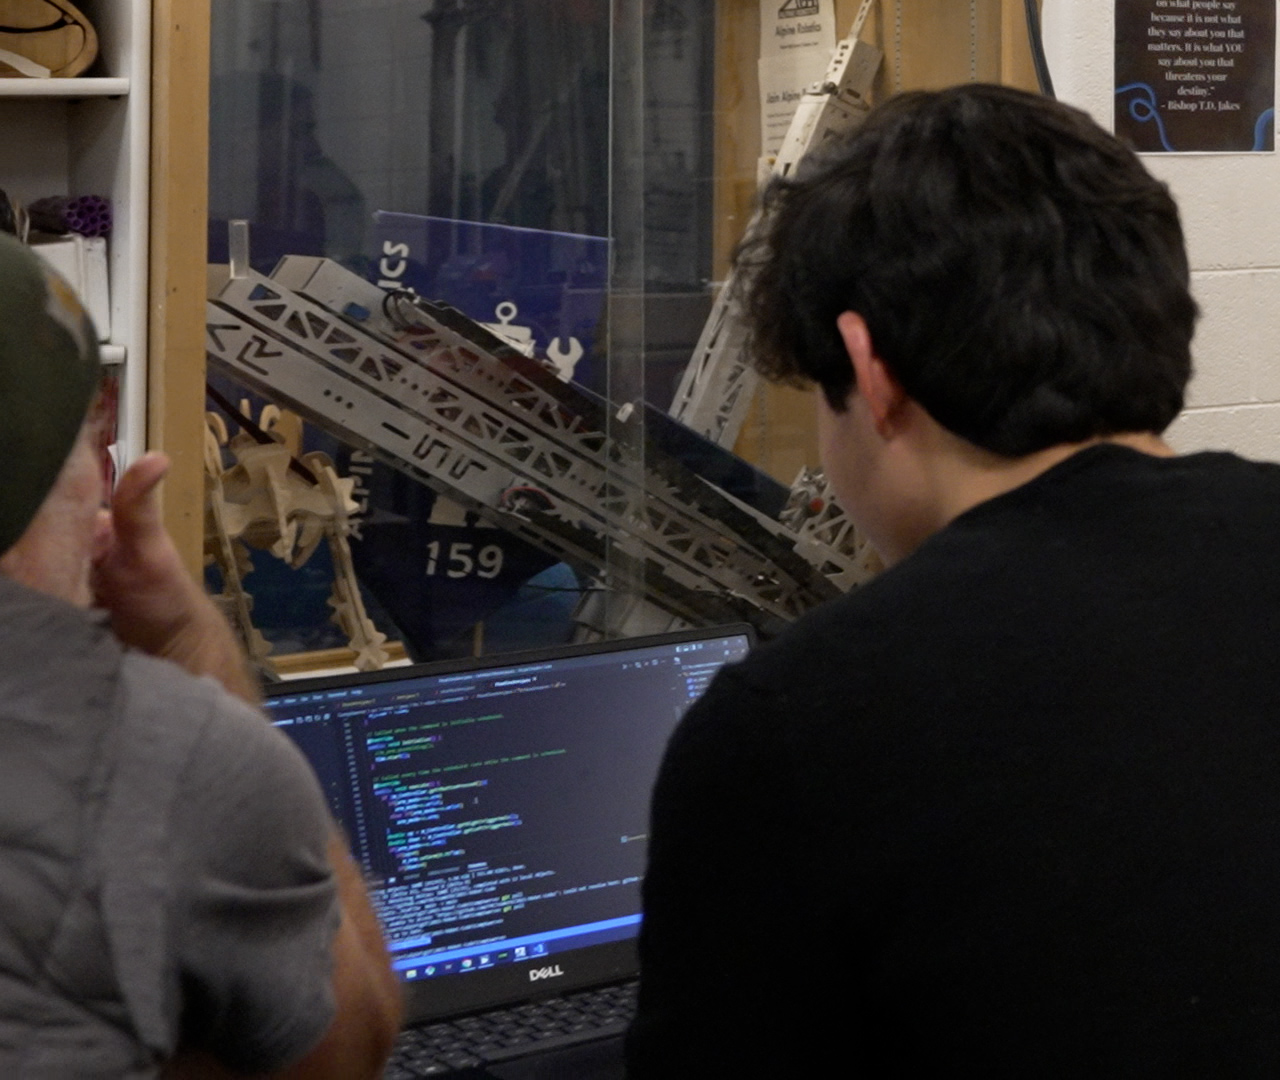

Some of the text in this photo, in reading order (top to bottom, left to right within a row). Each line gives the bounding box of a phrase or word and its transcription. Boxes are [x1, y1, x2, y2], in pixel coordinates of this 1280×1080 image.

[377, 240, 409, 288] ICS
[426, 540, 504, 579] 159
[529, 964, 564, 982] DELL
